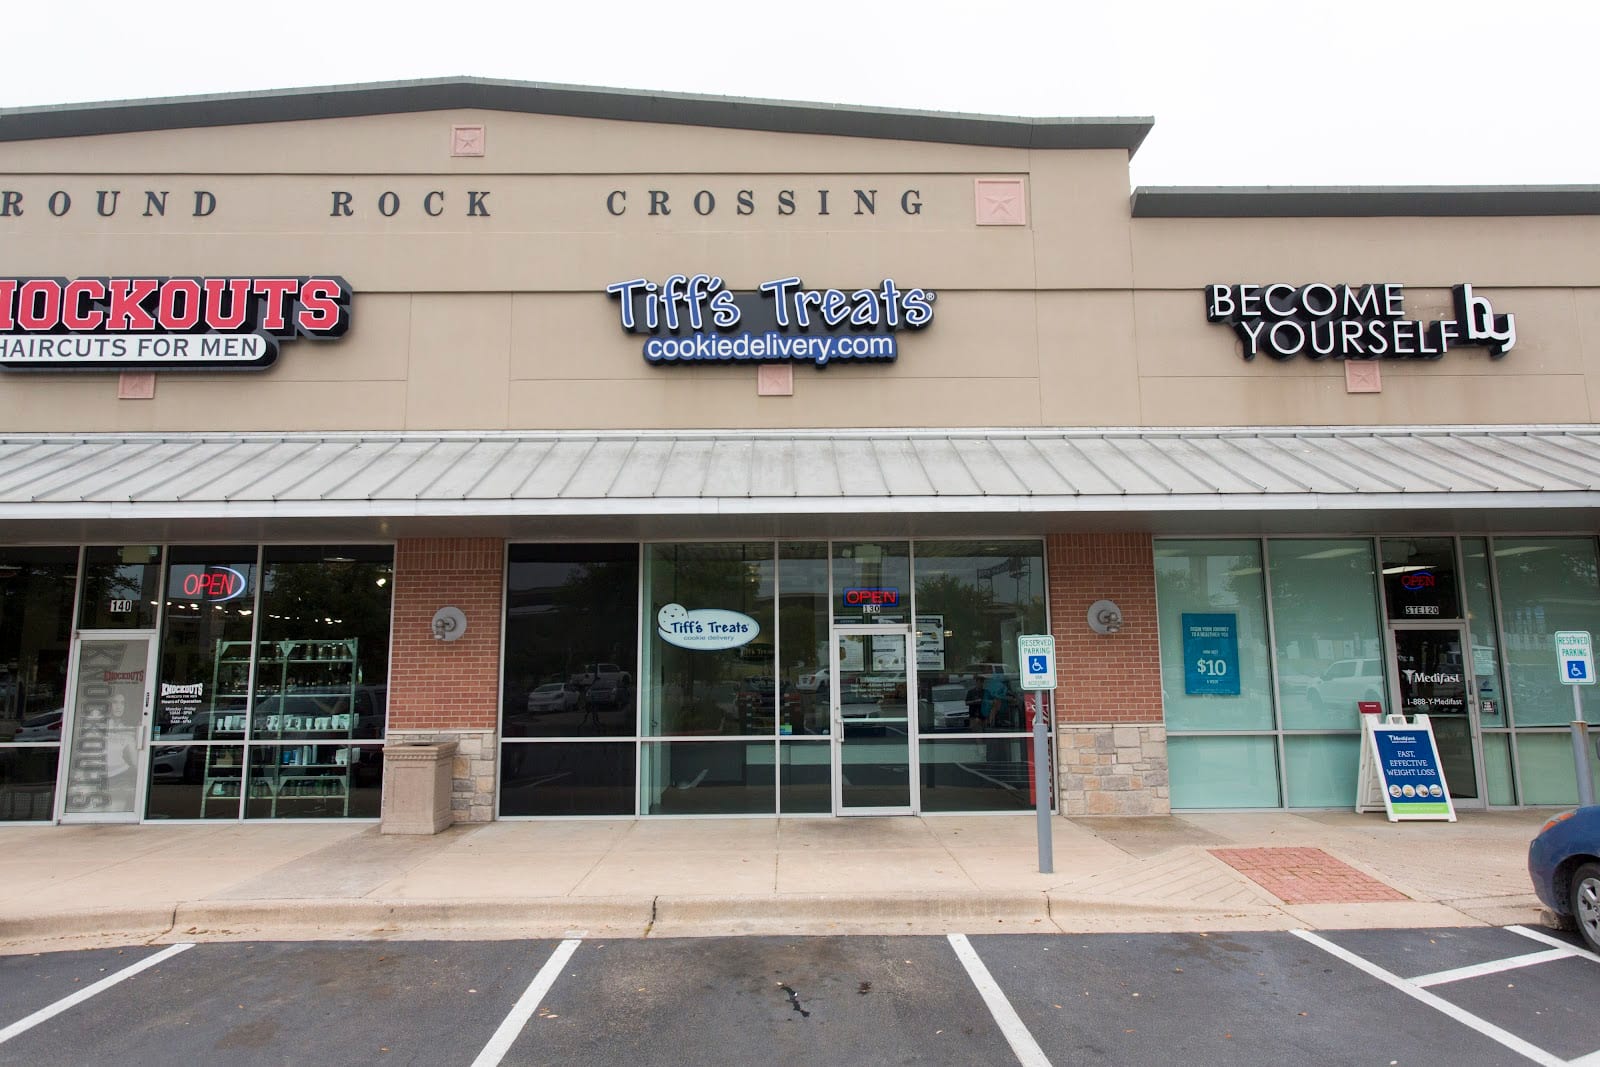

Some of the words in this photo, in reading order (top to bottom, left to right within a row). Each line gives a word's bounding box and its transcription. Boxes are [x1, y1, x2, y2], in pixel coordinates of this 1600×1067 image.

[0, 191, 217, 217] ROUND
[330, 191, 491, 217] ROCK
[606, 190, 924, 216] CROSSING
[607, 274, 741, 329] Tiff's
[1213, 283, 1406, 317] BECOME
[1241, 320, 1459, 354] YOURSELF
[137, 338, 189, 358] FOR
[200, 338, 258, 357] MEN
[647, 334, 893, 361] cookiedelivery.com
[184, 574, 235, 595] OPEN
[1401, 575, 1436, 587] OPEN
[846, 590, 897, 604] OPEN
[112, 601, 131, 612] 140
[863, 605, 880, 613] 130
[670, 621, 703, 633] Tiff's
[707, 621, 749, 633] Treats
[1557, 636, 1588, 644] RESERVED
[1562, 648, 1586, 656] PARKING
[1197, 657, 1227, 676] $10
[1414, 672, 1460, 684] Medifast
[161, 682, 203, 697] KNOCKOUTS
